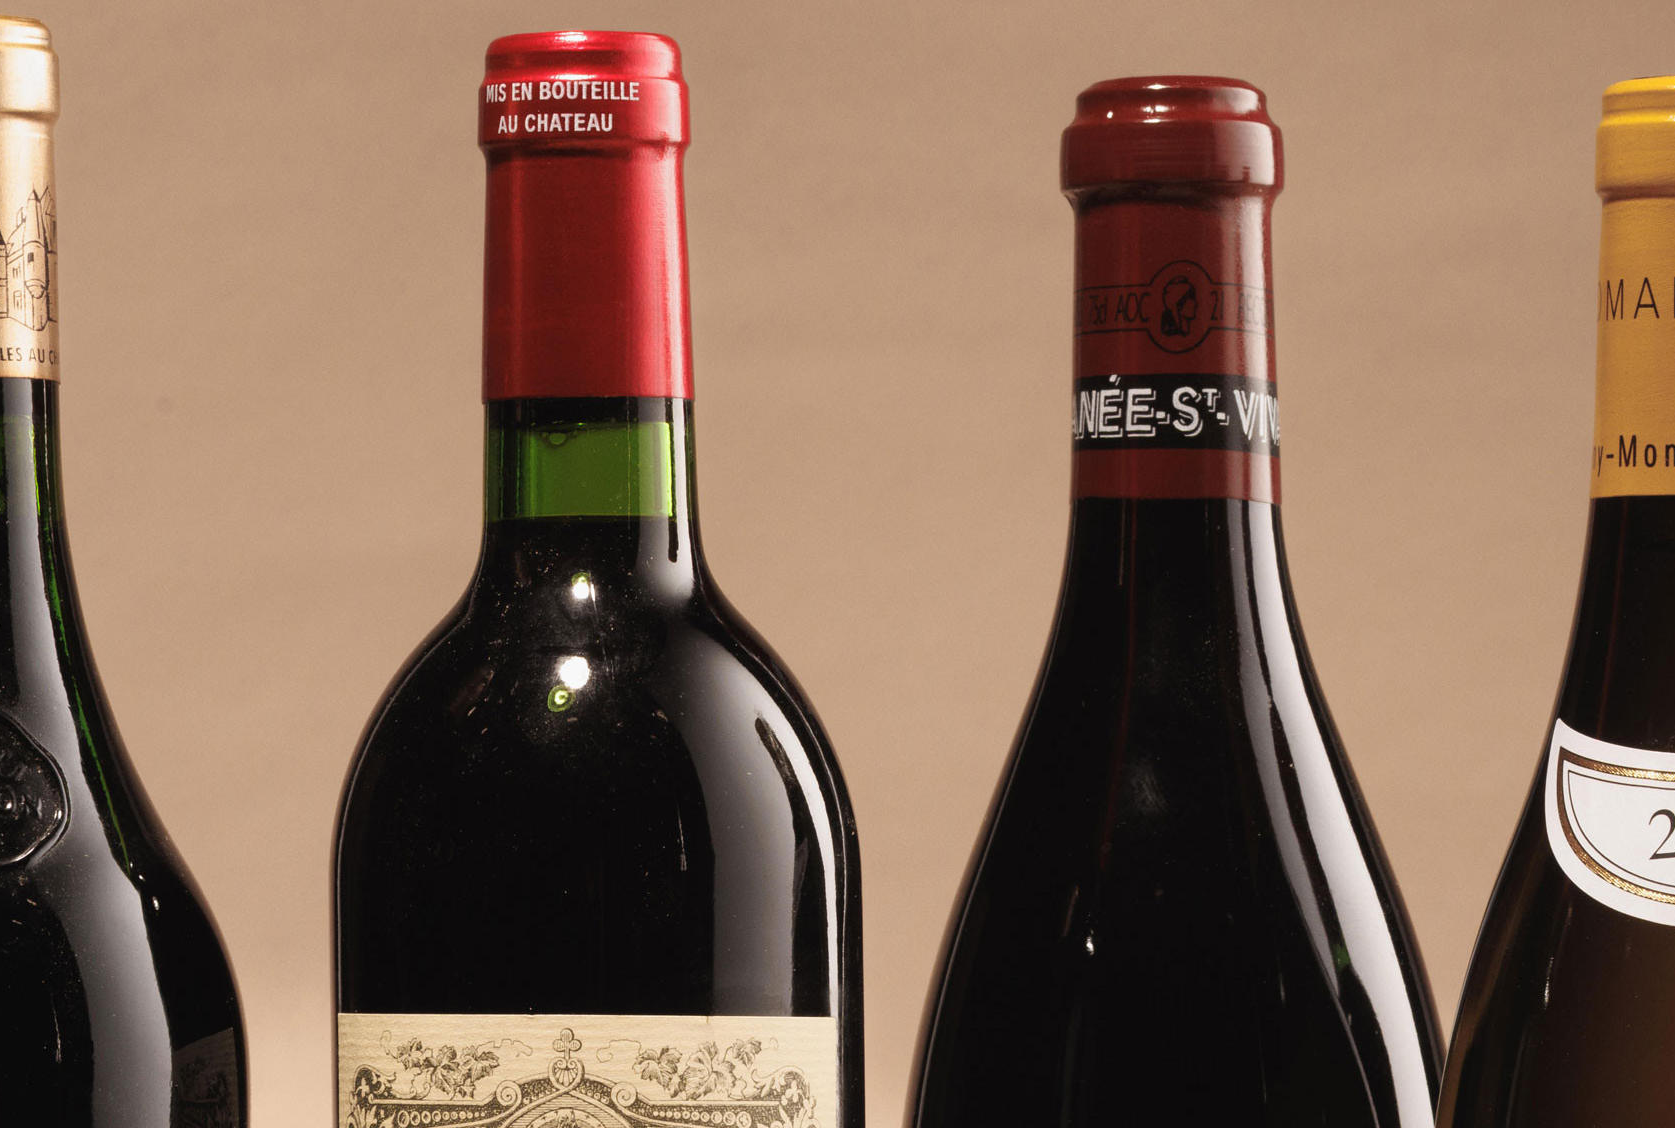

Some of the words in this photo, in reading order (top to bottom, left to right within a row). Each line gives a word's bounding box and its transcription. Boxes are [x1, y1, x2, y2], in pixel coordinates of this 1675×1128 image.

[486, 83, 506, 104] MIS
[512, 82, 533, 102] EN
[539, 81, 640, 101] BOUTEILLE
[497, 115, 518, 134] AU
[524, 113, 613, 133] CHATEAU
[29, 348, 45, 363] AU
